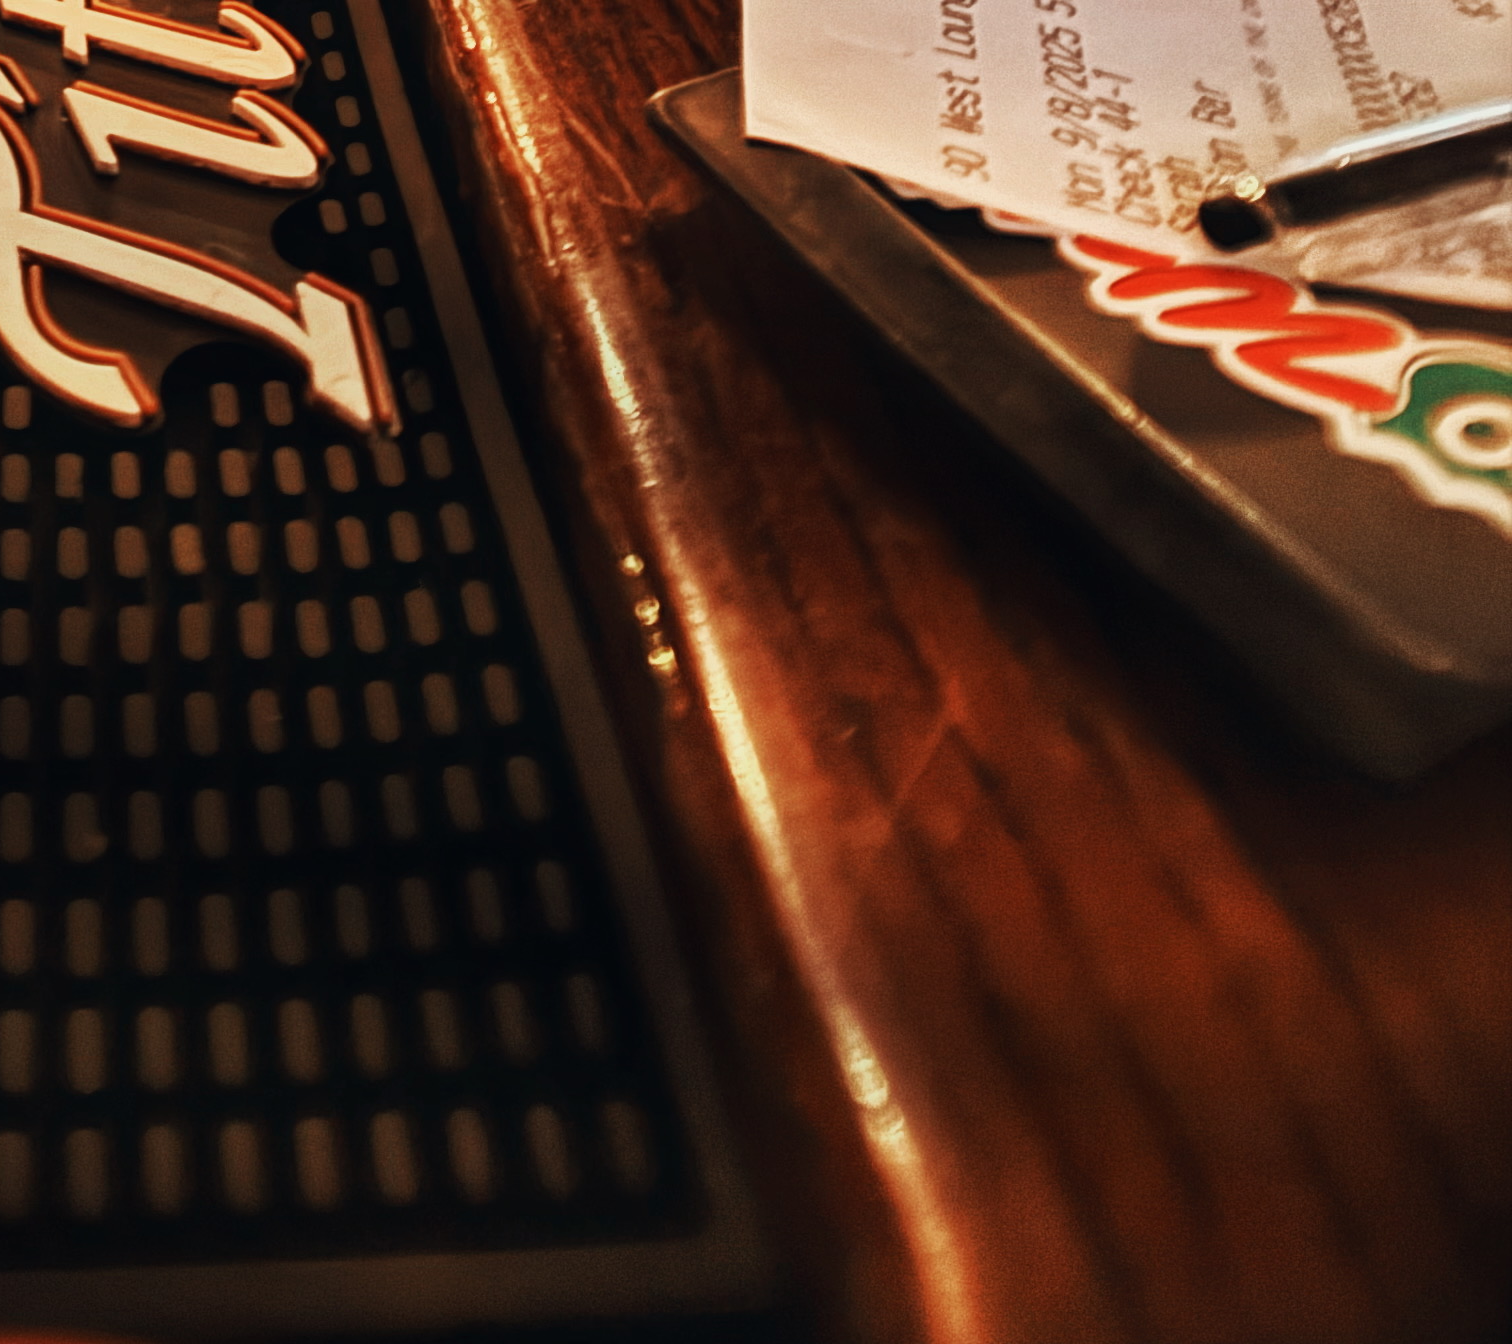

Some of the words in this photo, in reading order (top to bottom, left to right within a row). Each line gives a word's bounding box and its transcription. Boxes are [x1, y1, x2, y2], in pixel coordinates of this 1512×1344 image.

[937, 69, 983, 137] West
[1037, 22, 1101, 151] 9/8/2025
[1090, 67, 1141, 132] 44-1
[1190, 79, 1237, 129] Bar
[1064, 162, 1108, 213] Mon
[1101, 144, 1163, 228] Check
